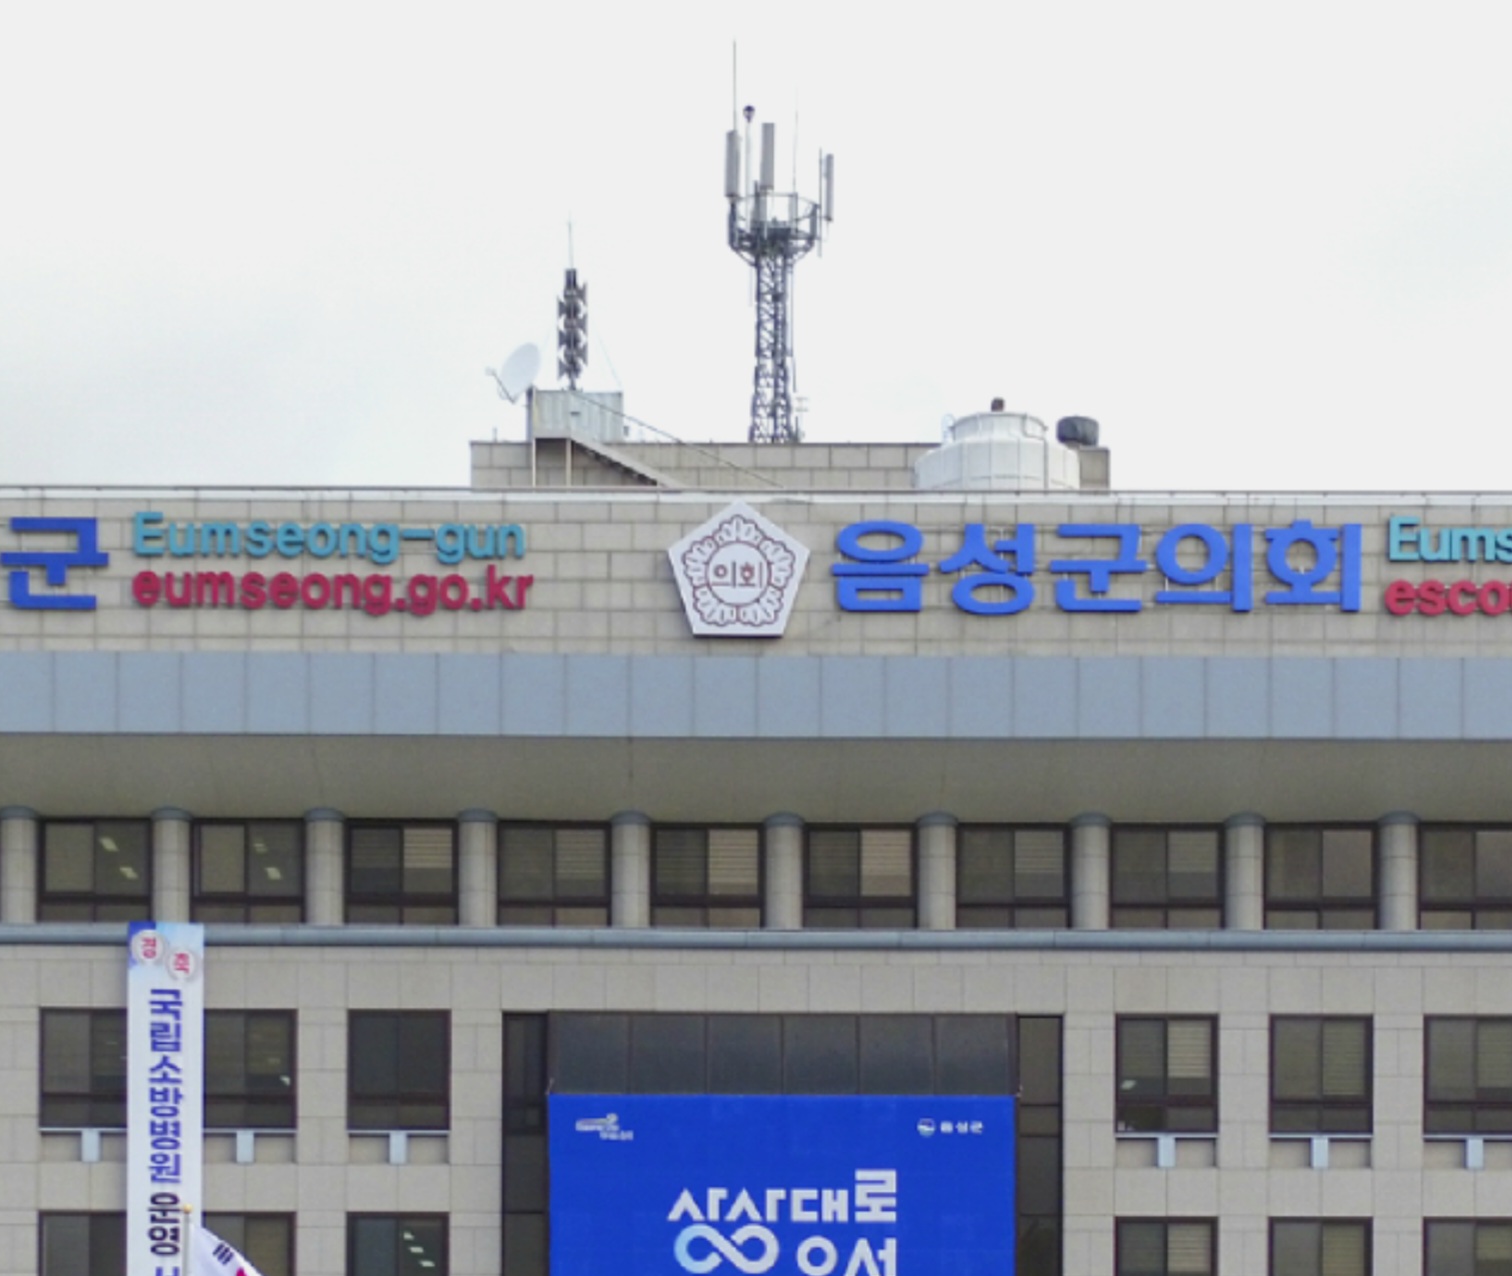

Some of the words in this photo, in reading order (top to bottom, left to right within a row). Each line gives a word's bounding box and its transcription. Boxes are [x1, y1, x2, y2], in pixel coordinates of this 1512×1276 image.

[133, 510, 526, 564] Eumseong-gun
[132, 564, 535, 616] eumseong.go.kr
[712, 562, 765, 589] 의회
[831, 519, 1362, 615] 음성군의회
[148, 988, 184, 1185] 국립소방병원
[148, 1192, 181, 1257] 운영
